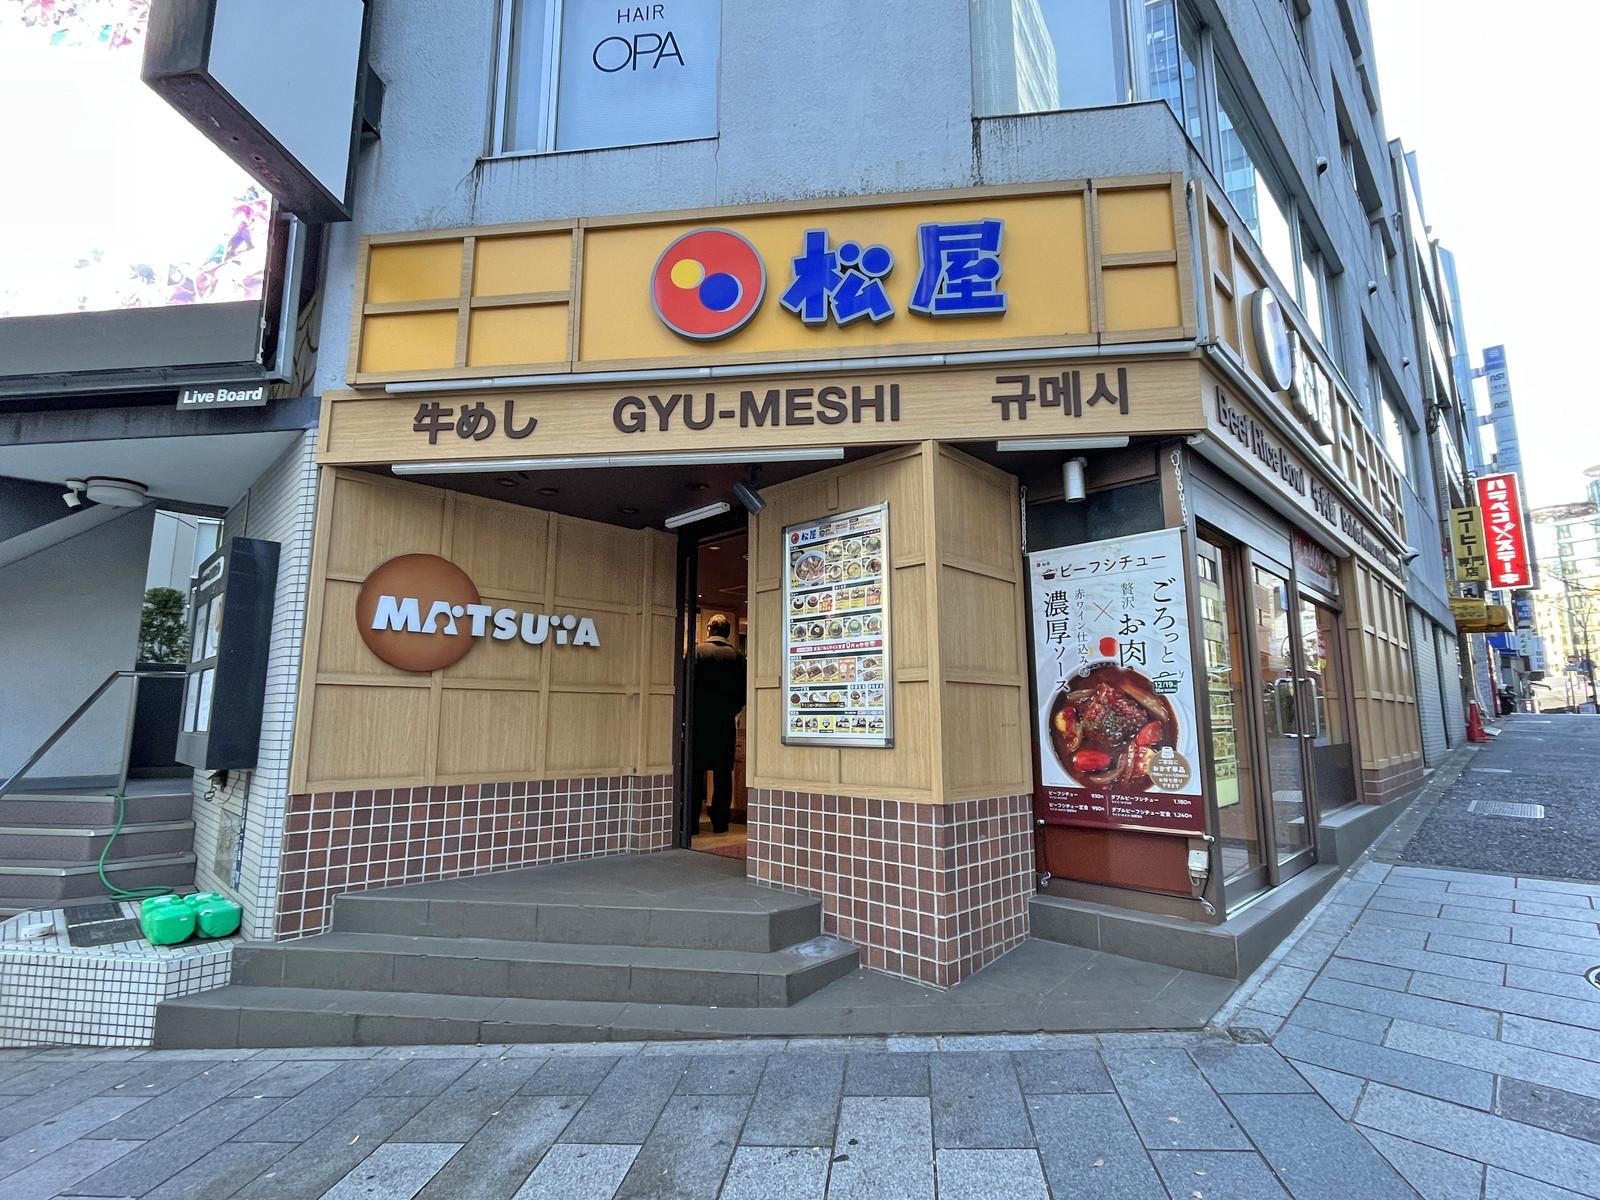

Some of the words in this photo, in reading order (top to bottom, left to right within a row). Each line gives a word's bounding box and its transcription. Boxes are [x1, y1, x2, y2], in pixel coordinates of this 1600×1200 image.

[617, 4, 665, 24] HAIR
[593, 31, 685, 73] OPA
[779, 218, 1008, 329] 松屋
[183, 390, 215, 404] Live
[216, 387, 263, 402] Board
[613, 384, 900, 434] GYU-MESHI
[992, 367, 1129, 420] 규메시
[413, 400, 537, 444] 牛めし
[1060, 555, 1166, 578] ビーフシチュー
[371, 595, 601, 647] MATSUYA
[1152, 577, 1179, 664] ごろっと
